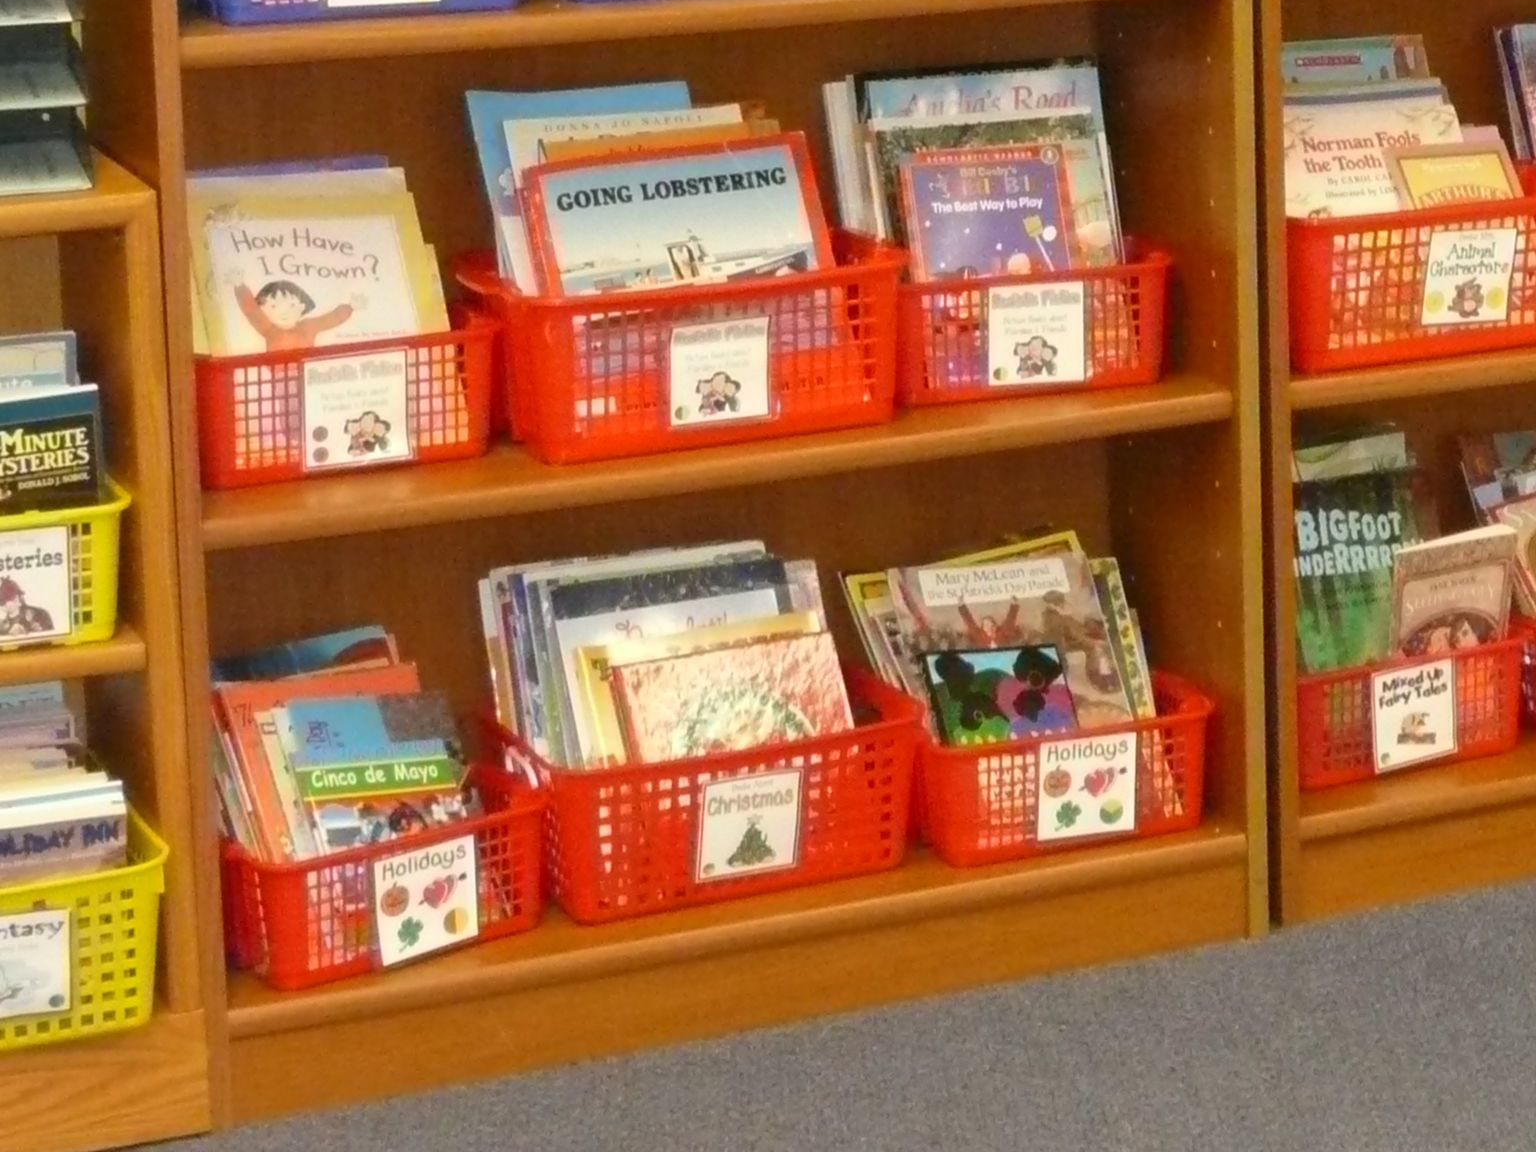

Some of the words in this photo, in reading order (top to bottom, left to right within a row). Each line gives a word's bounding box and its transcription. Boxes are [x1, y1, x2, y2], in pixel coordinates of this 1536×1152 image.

[1011, 79, 1077, 111] Road
[1301, 131, 1374, 154] Norman
[1376, 129, 1422, 148] Fools
[1303, 158, 1331, 174] the
[1336, 153, 1383, 171] Tooth
[556, 185, 634, 213] GOING
[641, 166, 788, 203] LOBSTERING
[930, 201, 953, 214] The
[953, 199, 979, 212] Best
[979, 199, 1006, 213] Way
[1006, 199, 1019, 211] to
[1018, 196, 1044, 211] Play
[230, 229, 284, 255] How
[292, 226, 355, 257] Have
[1447, 241, 1495, 261] Animal
[259, 255, 271, 276] I
[278, 252, 381, 283] Grown?
[0, 427, 89, 457] MINUTE
[17, 477, 54, 492] DONALD
[1294, 507, 1402, 551] BIGFOOT
[0, 547, 64, 573] steries
[934, 568, 972, 588] Mary
[972, 566, 1026, 583] McLean
[1029, 564, 1051, 579] and
[1381, 671, 1424, 694] Mixed
[1425, 668, 1444, 685] Up
[1377, 688, 1413, 711] Fairy
[1414, 681, 1449, 700] Tales
[1045, 738, 1130, 764] Holidays
[310, 767, 358, 790] Cinco
[364, 764, 387, 784] de
[393, 762, 439, 782] Mayo
[706, 787, 795, 816] Christmas
[380, 843, 468, 882] Holidays
